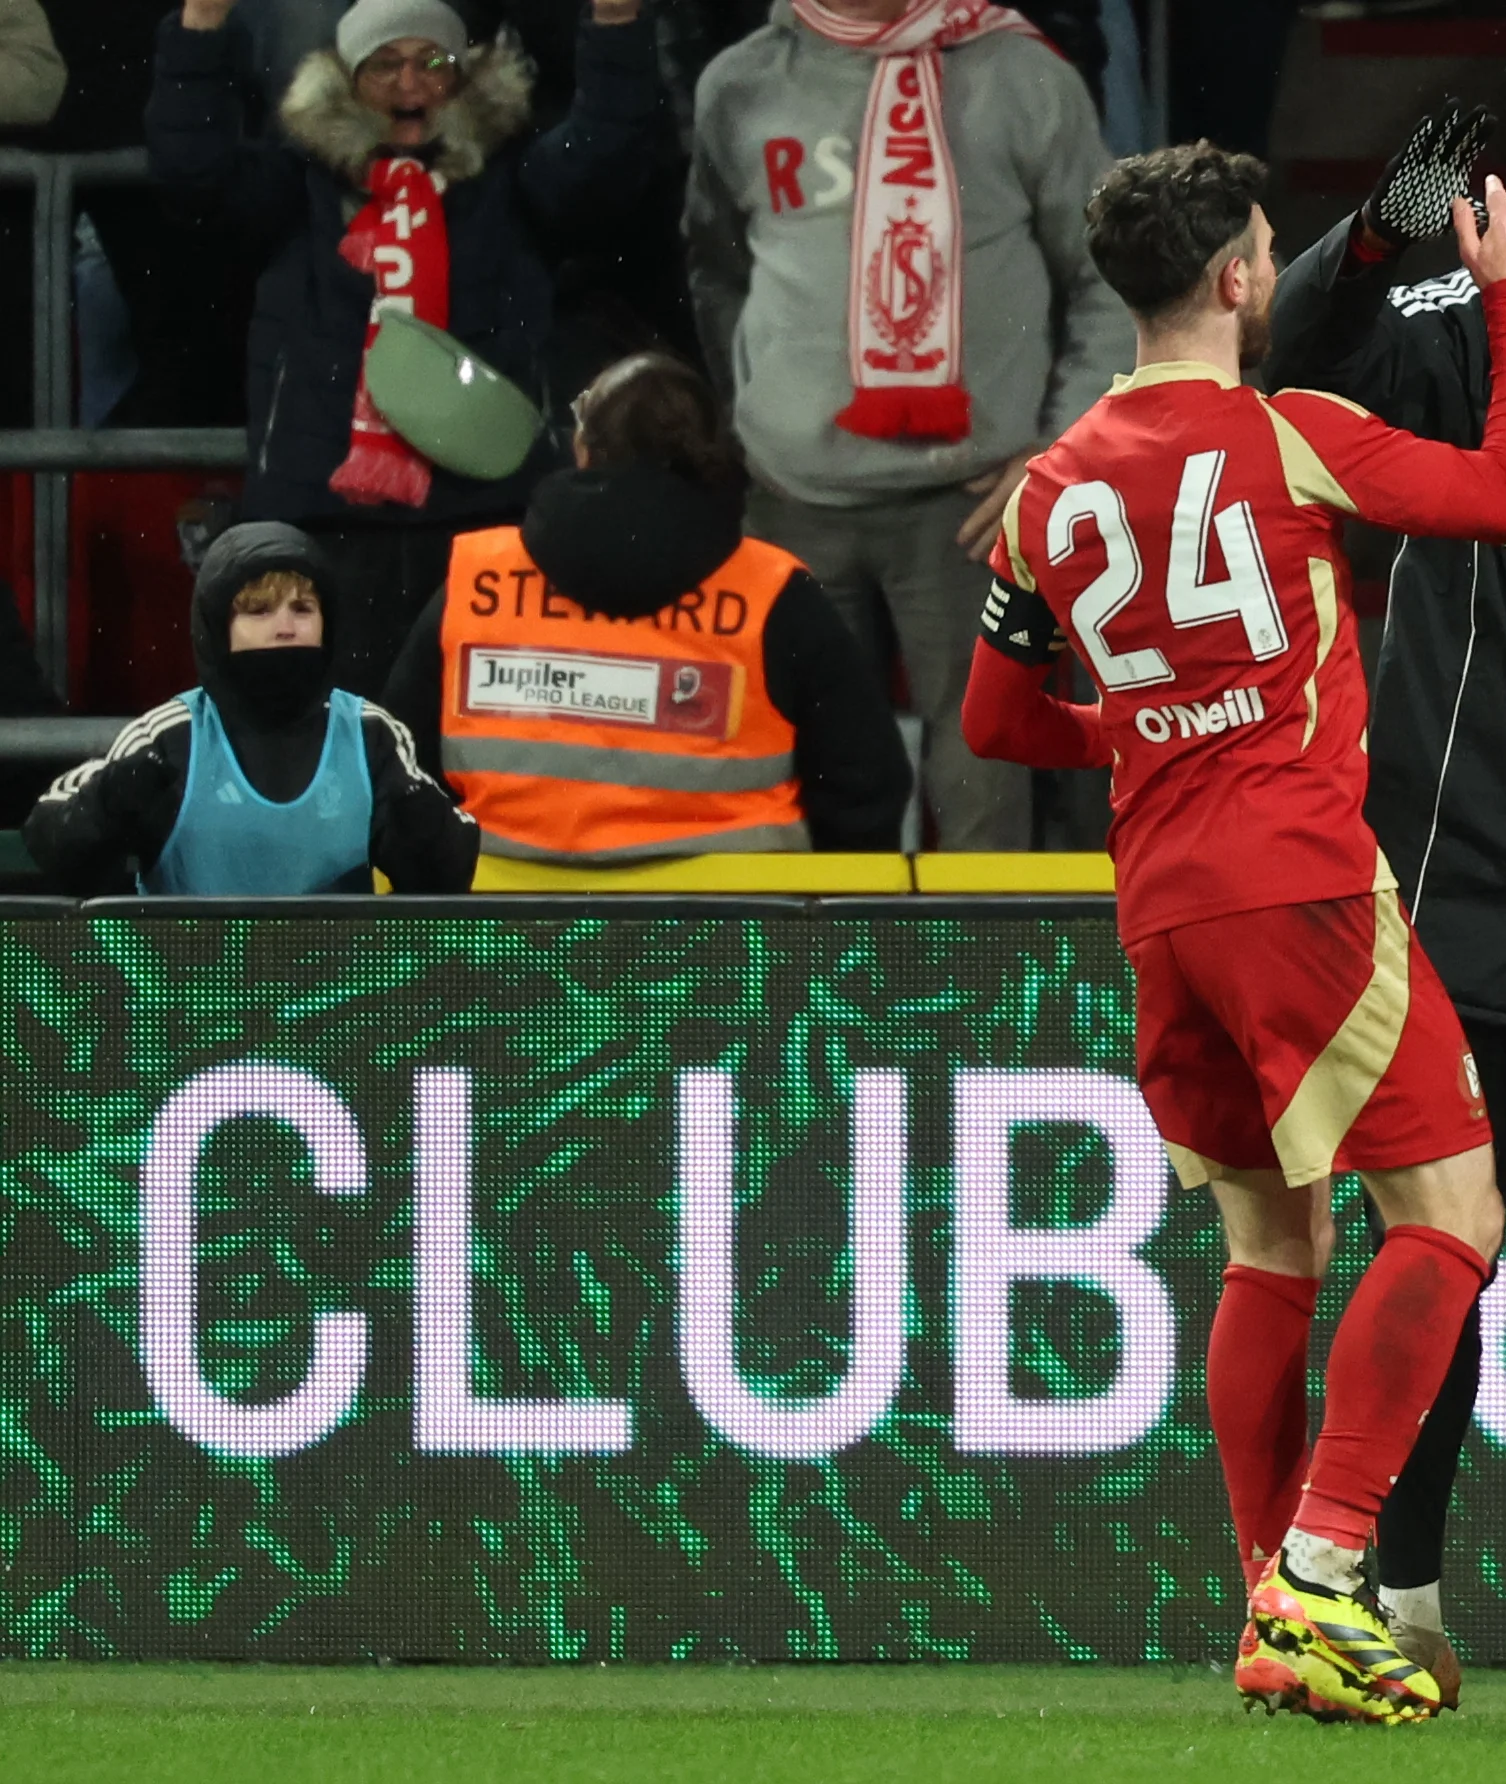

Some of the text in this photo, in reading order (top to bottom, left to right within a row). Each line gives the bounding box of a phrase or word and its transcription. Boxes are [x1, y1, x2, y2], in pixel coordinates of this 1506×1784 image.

[1047, 450, 1288, 691] 24
[478, 659, 586, 690] Jupiler
[524, 689, 648, 713] PRO LEAGUE
[1135, 686, 1265, 743] O'Neill
[138, 1060, 1178, 1458] CLUB
